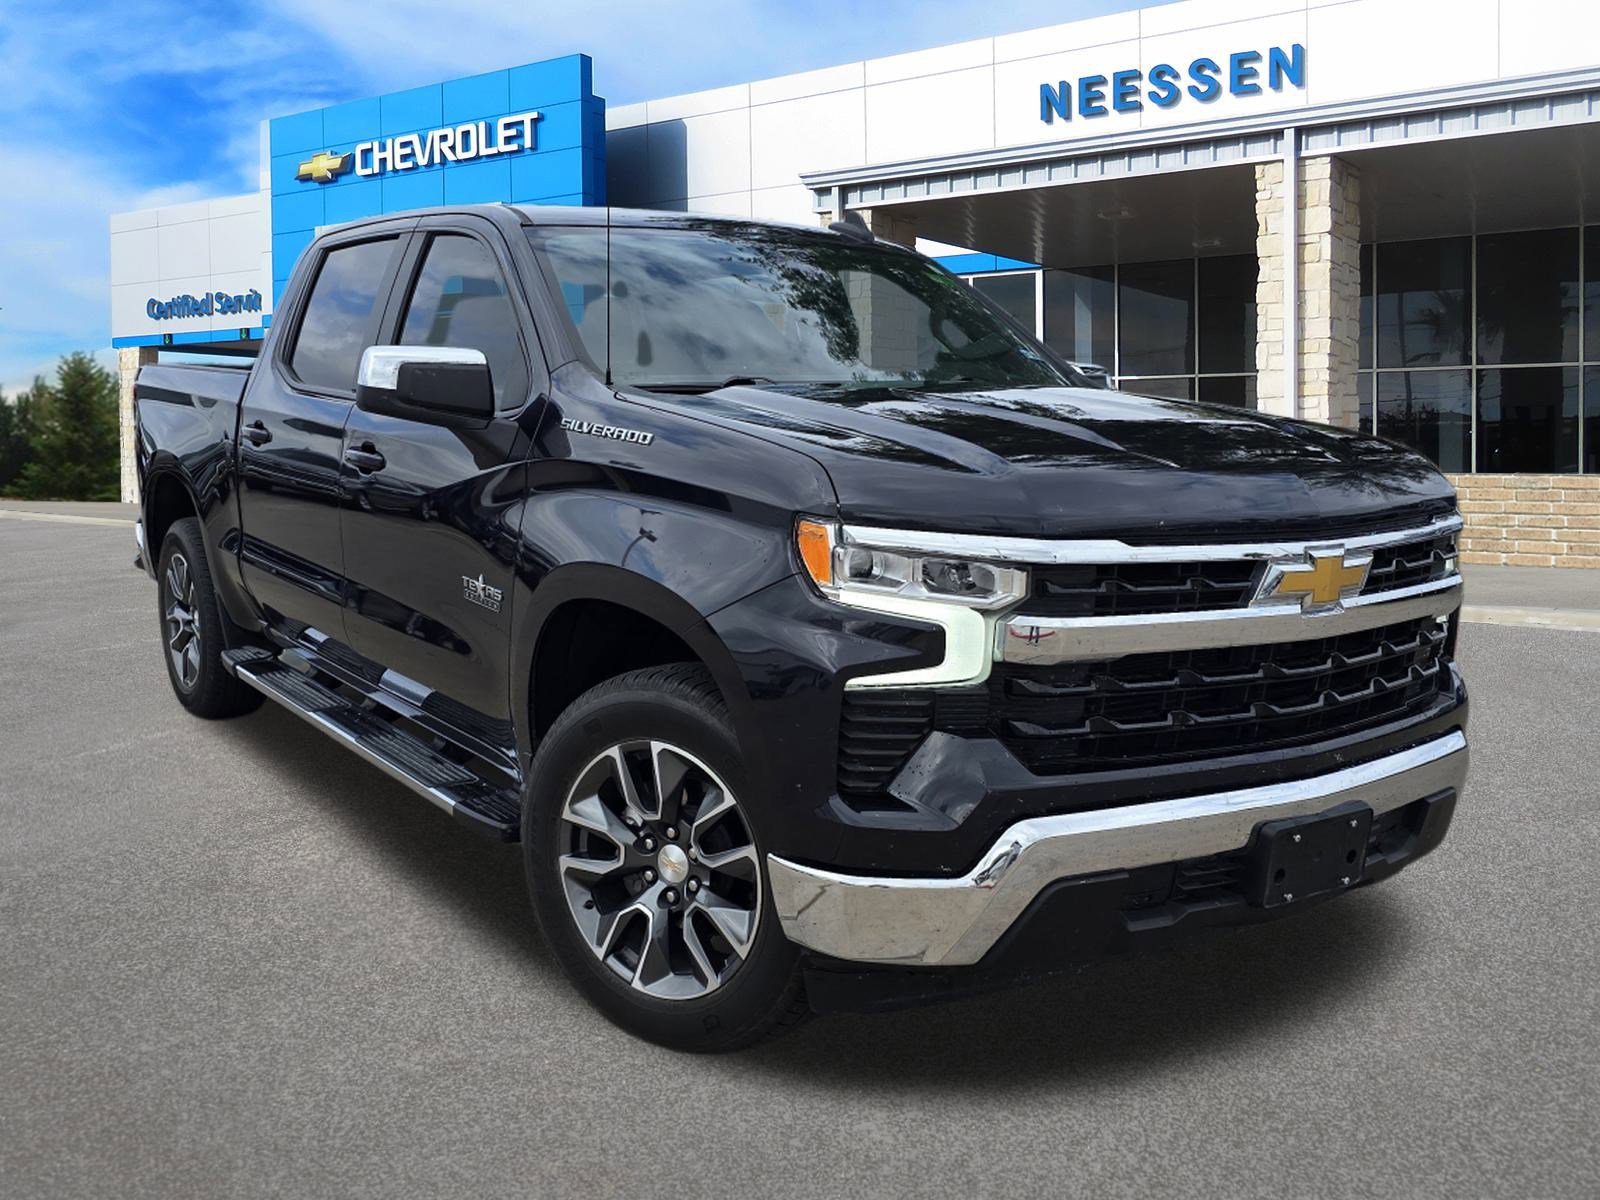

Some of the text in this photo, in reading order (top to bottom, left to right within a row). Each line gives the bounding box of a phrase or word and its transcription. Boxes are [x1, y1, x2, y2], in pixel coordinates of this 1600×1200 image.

[1040, 43, 1306, 125] NEESSEN
[354, 111, 544, 179] CHEVROLET
[146, 292, 214, 320] Certified
[560, 417, 654, 446] SILVERADO
